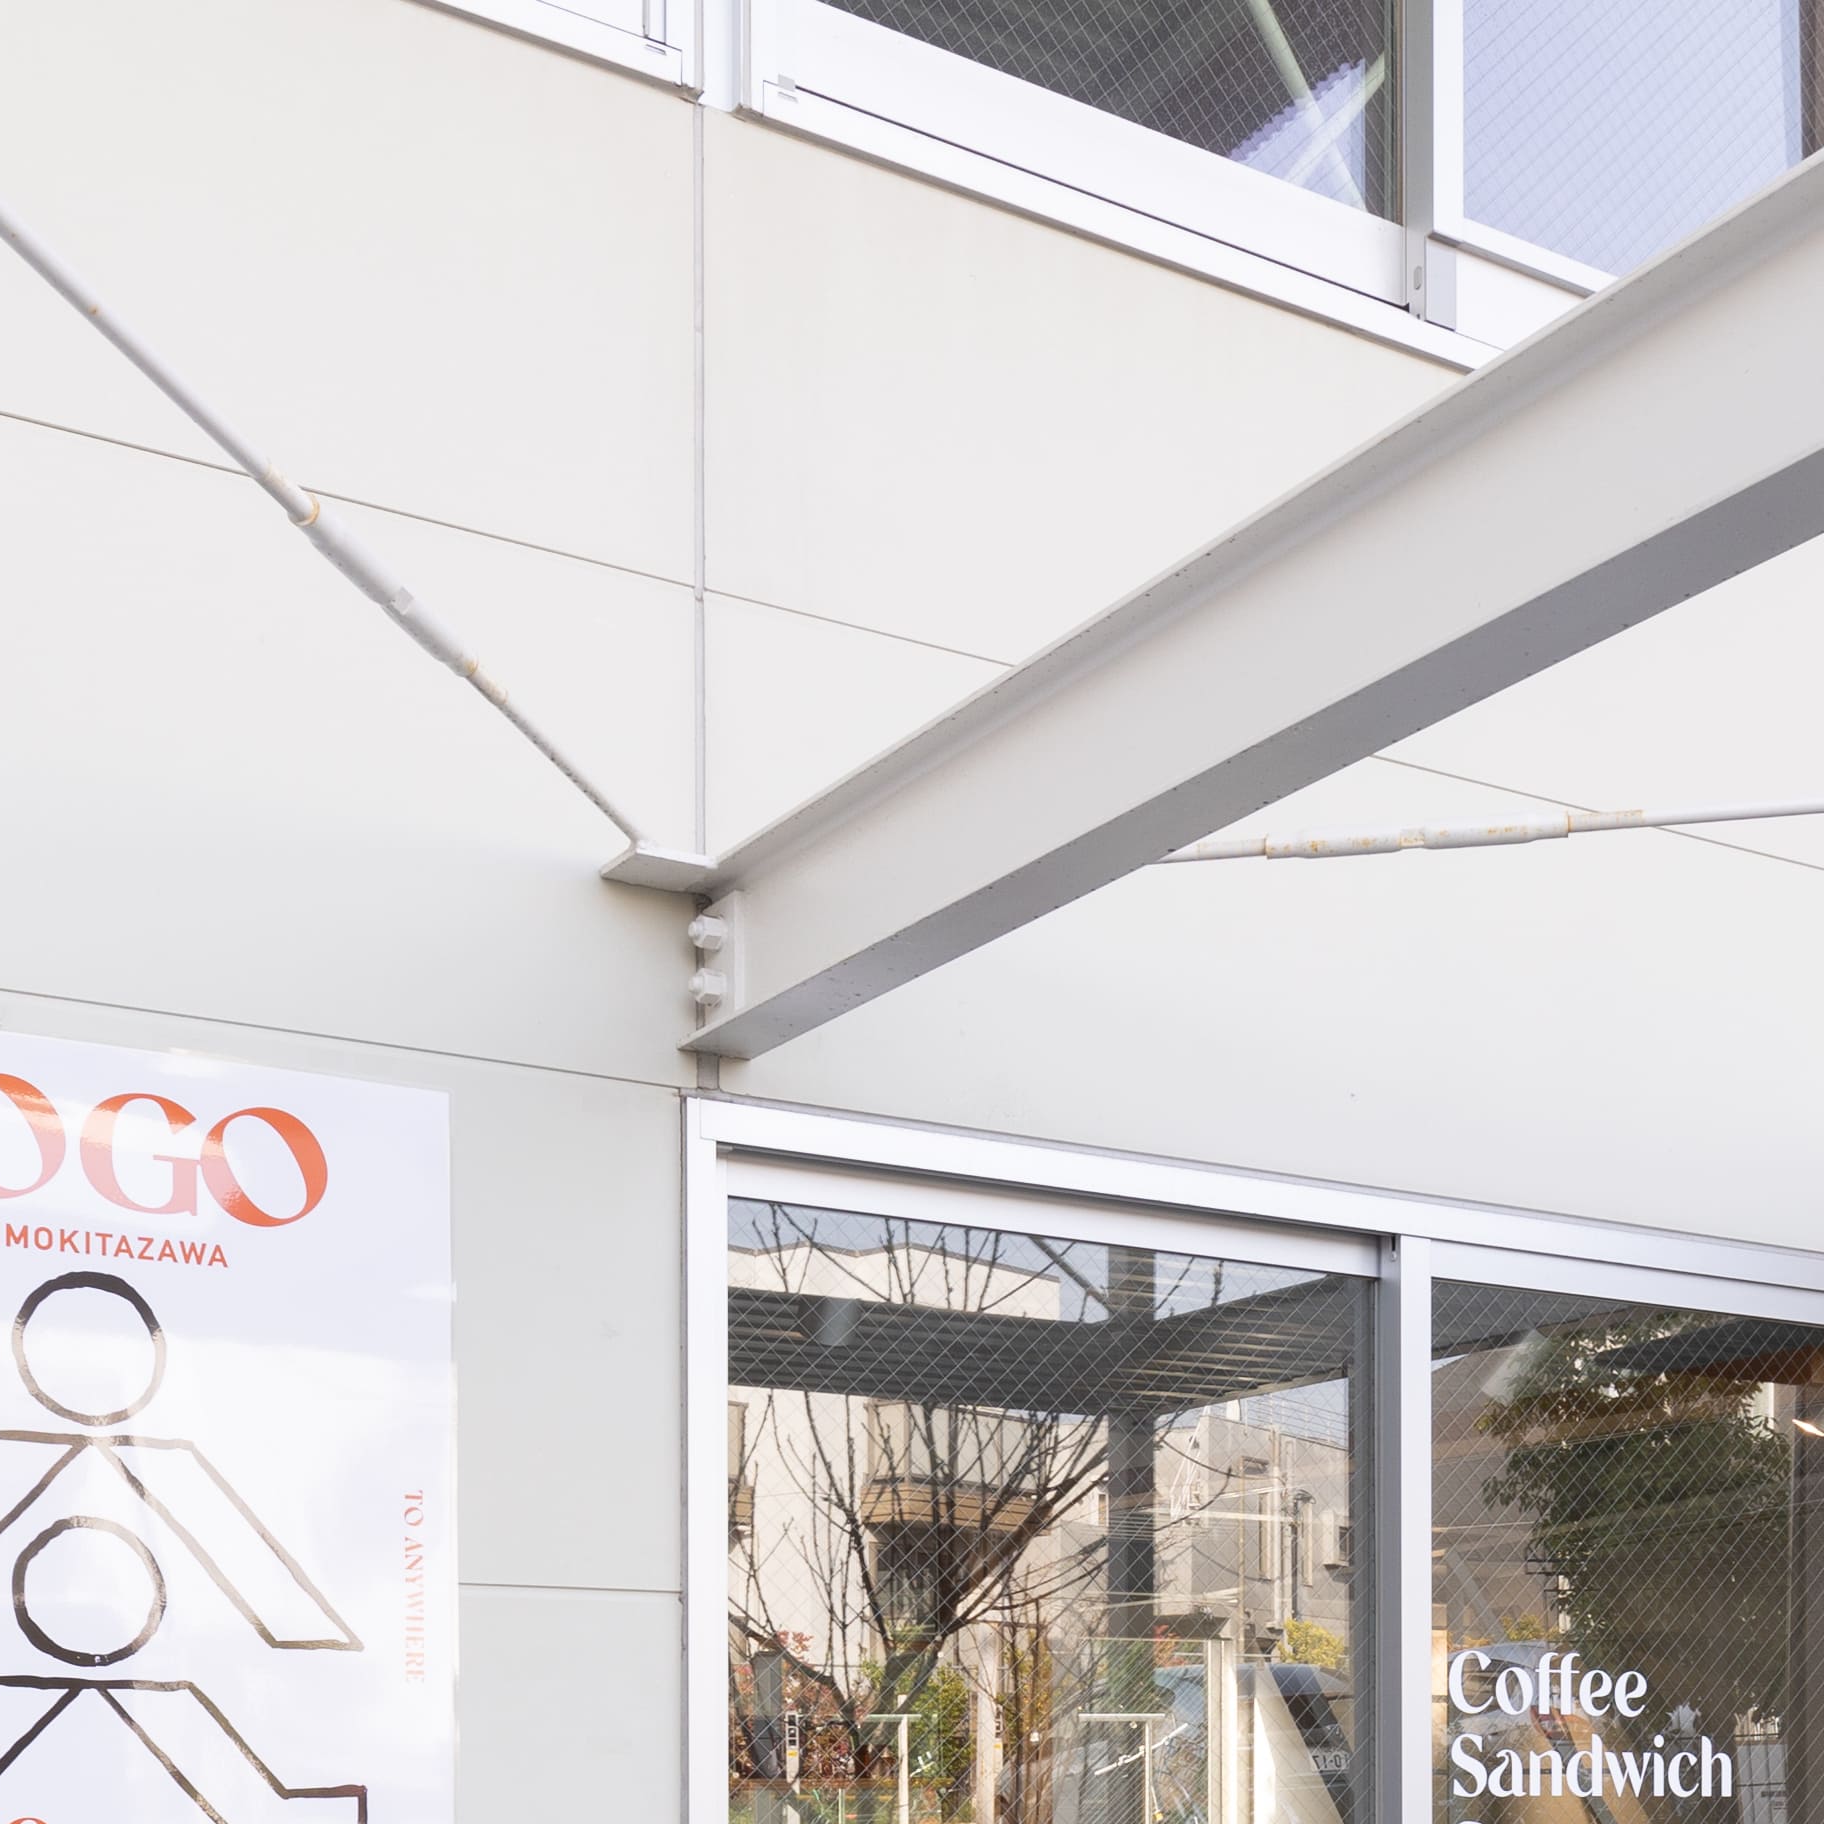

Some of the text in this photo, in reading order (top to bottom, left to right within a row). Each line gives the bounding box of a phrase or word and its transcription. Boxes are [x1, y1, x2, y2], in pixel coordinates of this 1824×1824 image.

[404, 1490, 424, 1526] TO
[1448, 1650, 1648, 1718] Coffee
[1452, 1735, 1733, 1799] Sandwich
